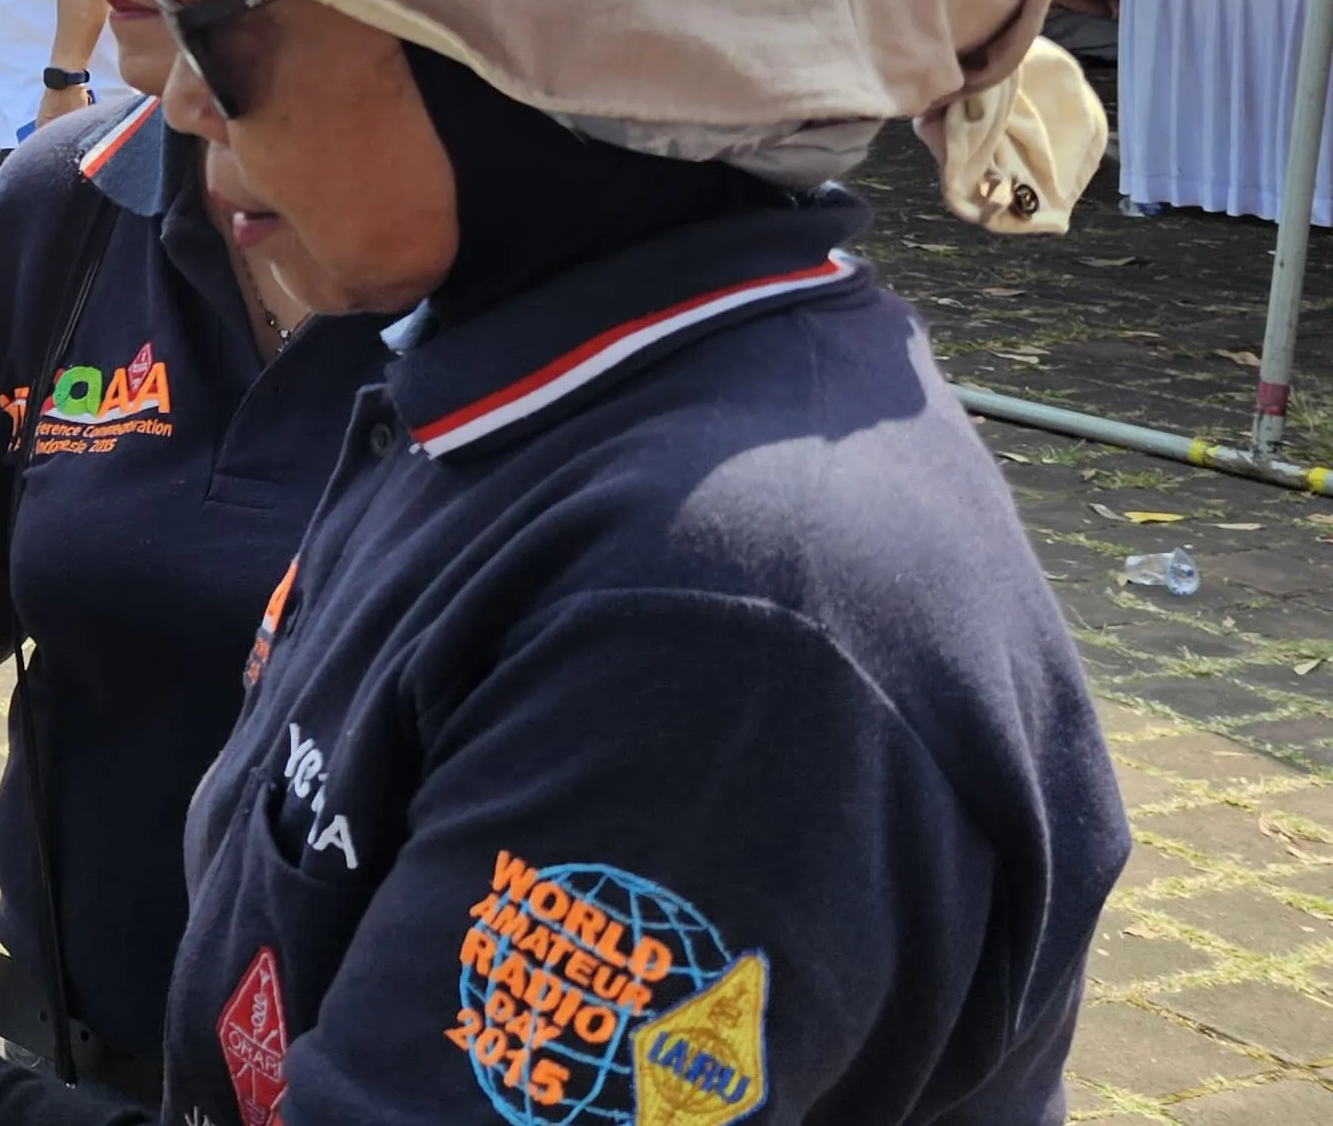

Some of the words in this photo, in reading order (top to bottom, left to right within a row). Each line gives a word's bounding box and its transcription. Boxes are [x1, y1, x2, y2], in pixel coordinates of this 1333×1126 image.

[468, 892, 653, 1017] AMATEUR
[490, 849, 673, 983] WORLD
[459, 928, 616, 1046] RADIO
[484, 988, 562, 1051] DAY
[444, 1006, 572, 1105] 2015
[647, 1031, 751, 1104] IARU
